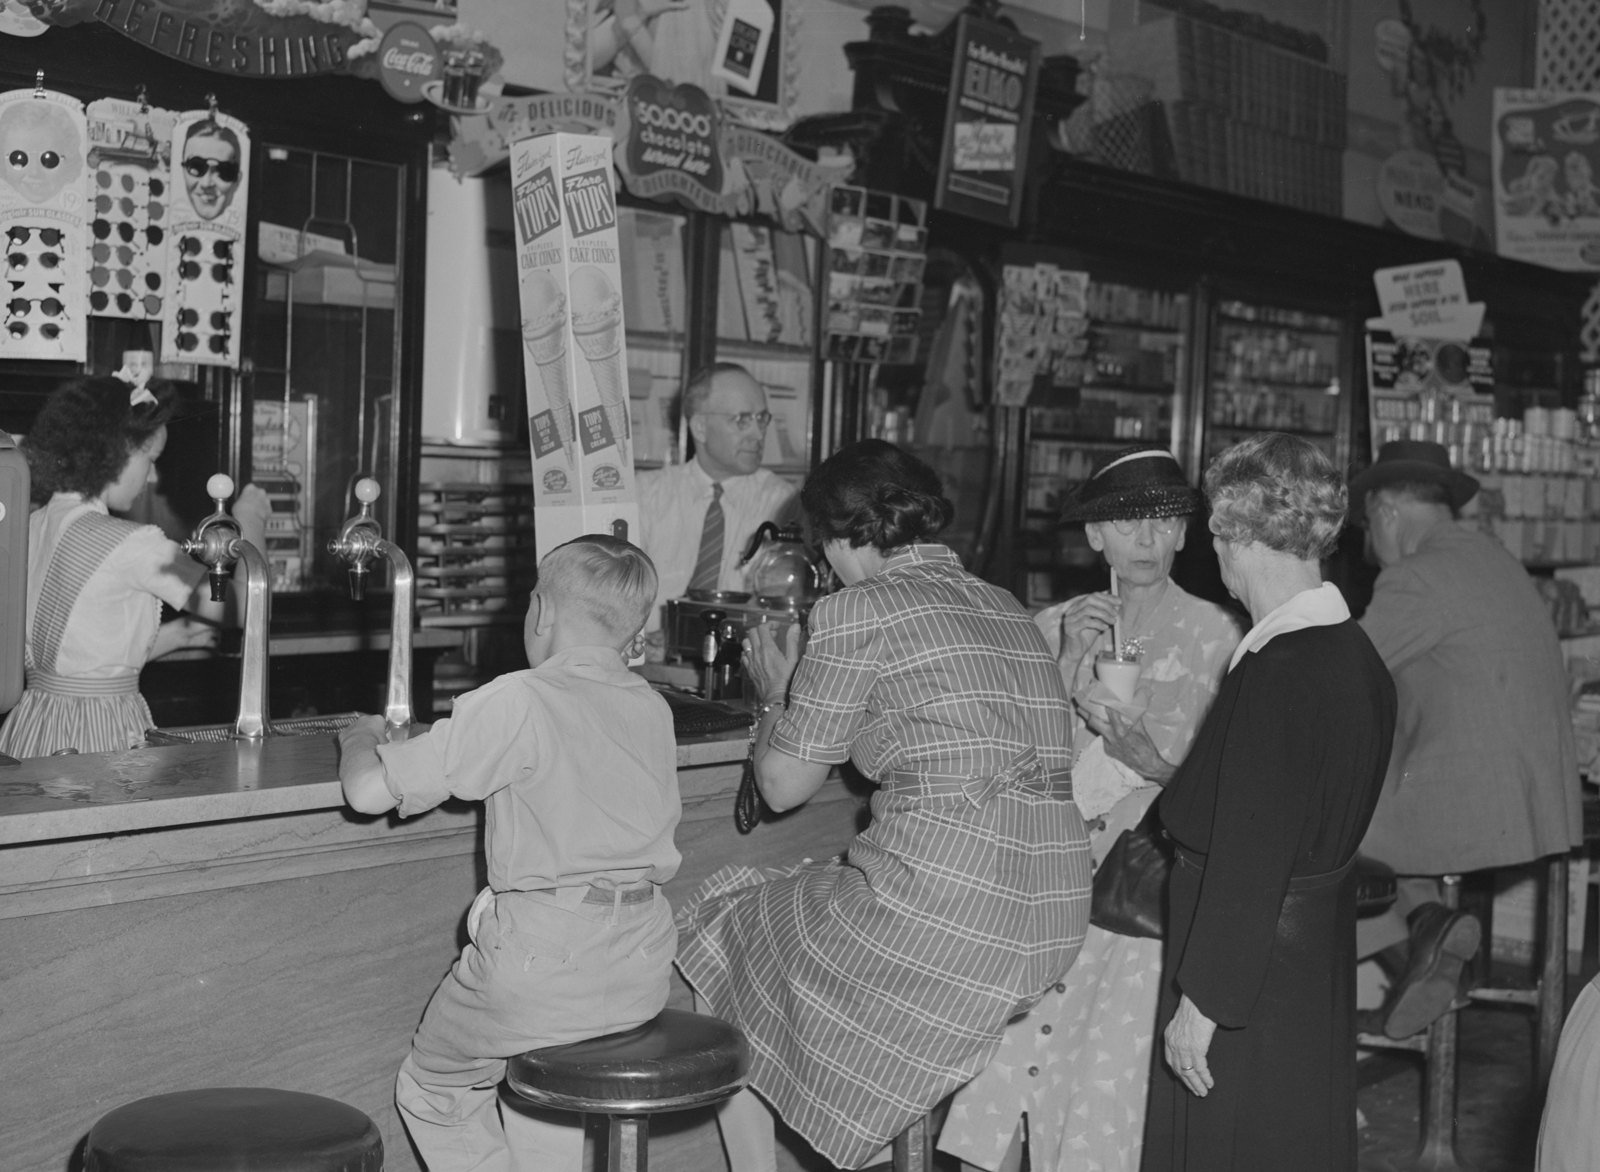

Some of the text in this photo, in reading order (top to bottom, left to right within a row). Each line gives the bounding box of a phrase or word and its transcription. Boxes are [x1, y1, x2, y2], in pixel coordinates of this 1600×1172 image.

[383, 48, 434, 76] Coca-Cola
[528, 98, 616, 128] DELICIOUS
[640, 125, 711, 158] chocolate
[516, 182, 560, 239] TOPS
[565, 182, 614, 233] TOPS
[521, 248, 562, 270] CAKE CONES
[569, 247, 617, 264] CAKE CONES
[583, 410, 603, 428] TOPS
